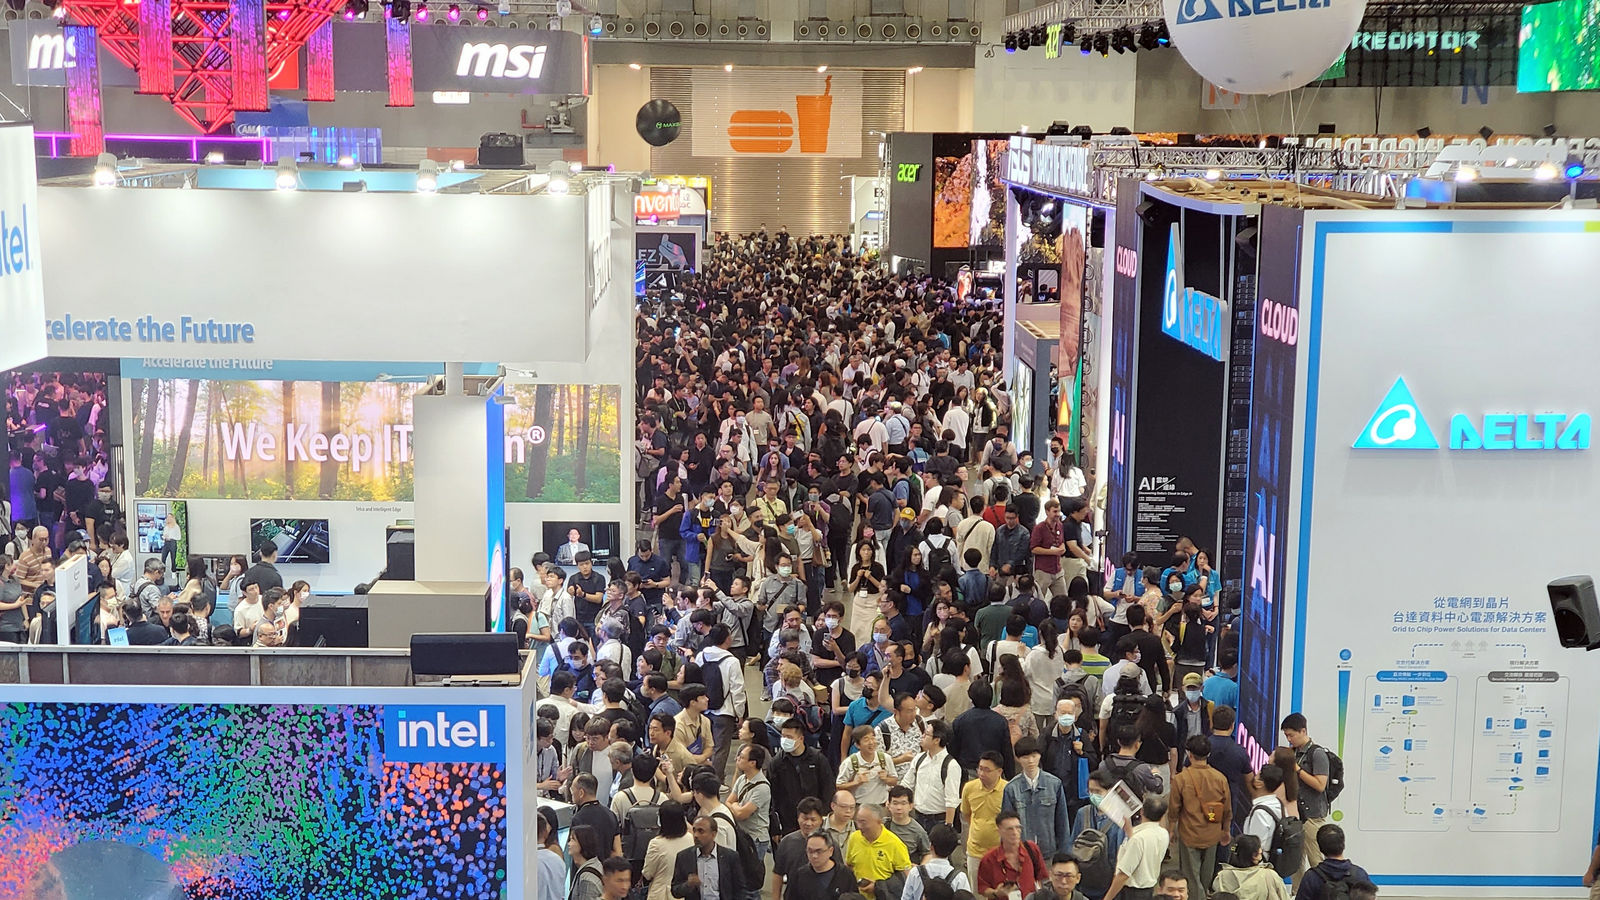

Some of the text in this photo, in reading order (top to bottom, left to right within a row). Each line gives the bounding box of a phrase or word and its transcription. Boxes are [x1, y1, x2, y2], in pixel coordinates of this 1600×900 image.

[1045, 23, 1062, 59] acer
[1351, 31, 1481, 52] REDATOR
[456, 43, 548, 79] msi
[897, 164, 920, 182] acer
[1116, 245, 1138, 279] CLOUD
[136, 315, 175, 343] the
[181, 316, 255, 343] Future
[1184, 287, 1223, 362] DELTA
[1260, 298, 1299, 346] CLOUD
[221, 422, 276, 461] We
[286, 423, 373, 472] Keep
[1112, 409, 1126, 465] AI
[1449, 412, 1592, 450] DELTA
[1138, 476, 1156, 491] AI
[1250, 524, 1276, 605] AI
[1392, 611, 1548, 624] 台達資料中心電源解決方案
[1433, 596, 1510, 610] 從電網到晶片
[1417, 626, 1433, 635] Chip
